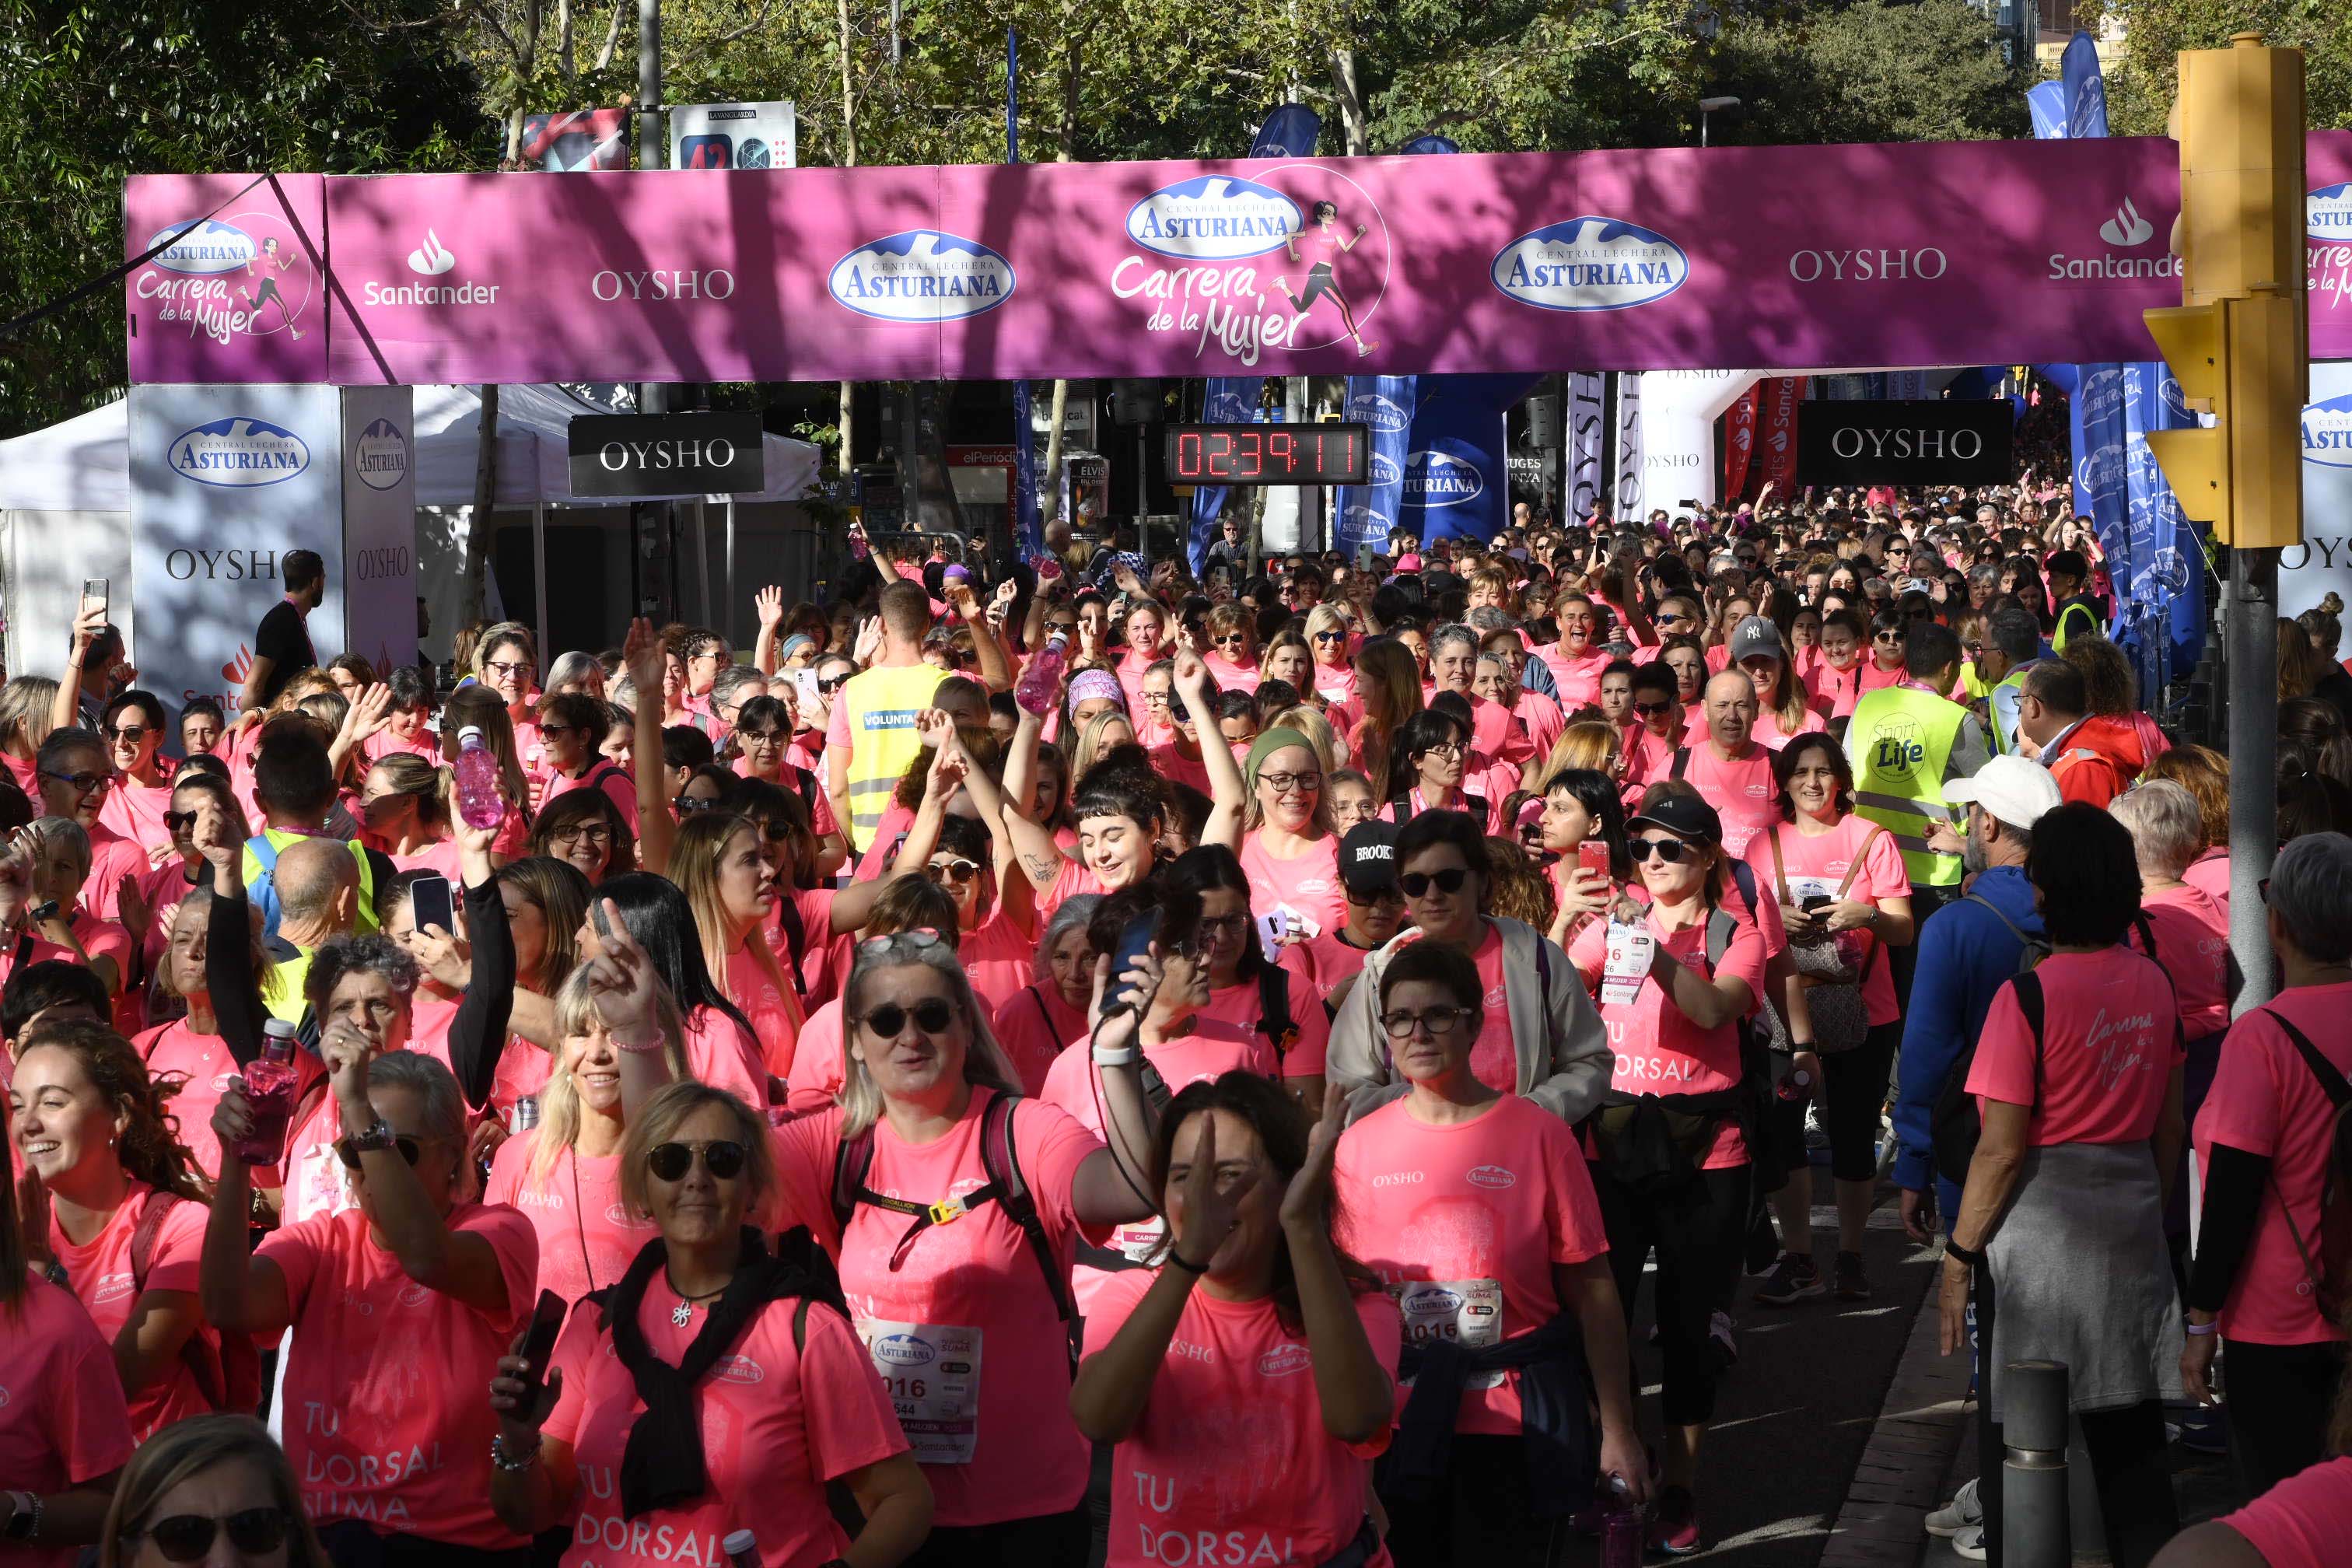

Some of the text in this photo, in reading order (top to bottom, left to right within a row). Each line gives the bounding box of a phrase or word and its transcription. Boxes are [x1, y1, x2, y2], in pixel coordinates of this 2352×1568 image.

[1139, 207, 1289, 239] ASTURIANA
[872, 261, 995, 271] CENTRAL LECHERA
[1537, 247, 1667, 261] CENTRAL LECHERA
[1790, 247, 1948, 282] OYSHO
[137, 271, 228, 299] Carrera
[592, 269, 735, 301] OYSHO
[843, 265, 1001, 298] ASTURIANA
[1111, 255, 1257, 299] Carrera
[1506, 254, 1675, 288] ASTURIANA
[364, 281, 499, 306] Santander
[159, 297, 263, 345] de la Mujer
[1146, 293, 1312, 366] de la Mujer
[179, 443, 300, 470] ASTURIANA
[600, 438, 735, 471] OYSHO
[1179, 433, 1353, 476] 02:39:11
[1573, 373, 1601, 522] OYSH
[1619, 372, 1642, 509] OYSH
[1832, 427, 1982, 460] OYSHO
[359, 443, 405, 472] ASTURIANA
[1080, 466, 1105, 476] ELVIS
[166, 548, 300, 581] OYSH
[357, 546, 409, 581] OYSHO
[2279, 536, 2352, 570] OY
[864, 714, 916, 726] VOLUNTA
[1873, 722, 1916, 744] Sport
[1877, 739, 1923, 772] Life
[1614, 1054, 1693, 1082] ORSAL
[1372, 1170, 1425, 1188] OYSHO
[1469, 1172, 1513, 1184] ASTURIANA
[1409, 1299, 1459, 1311] ASTURIANA
[878, 1344, 930, 1360] ASTURIANA
[304, 1401, 339, 1437] TU
[306, 1441, 445, 1487] DORSAL
[1133, 1470, 1175, 1513] TU
[578, 1512, 722, 1568] DORSAL
[1139, 1522, 1301, 1568] DORSAL
